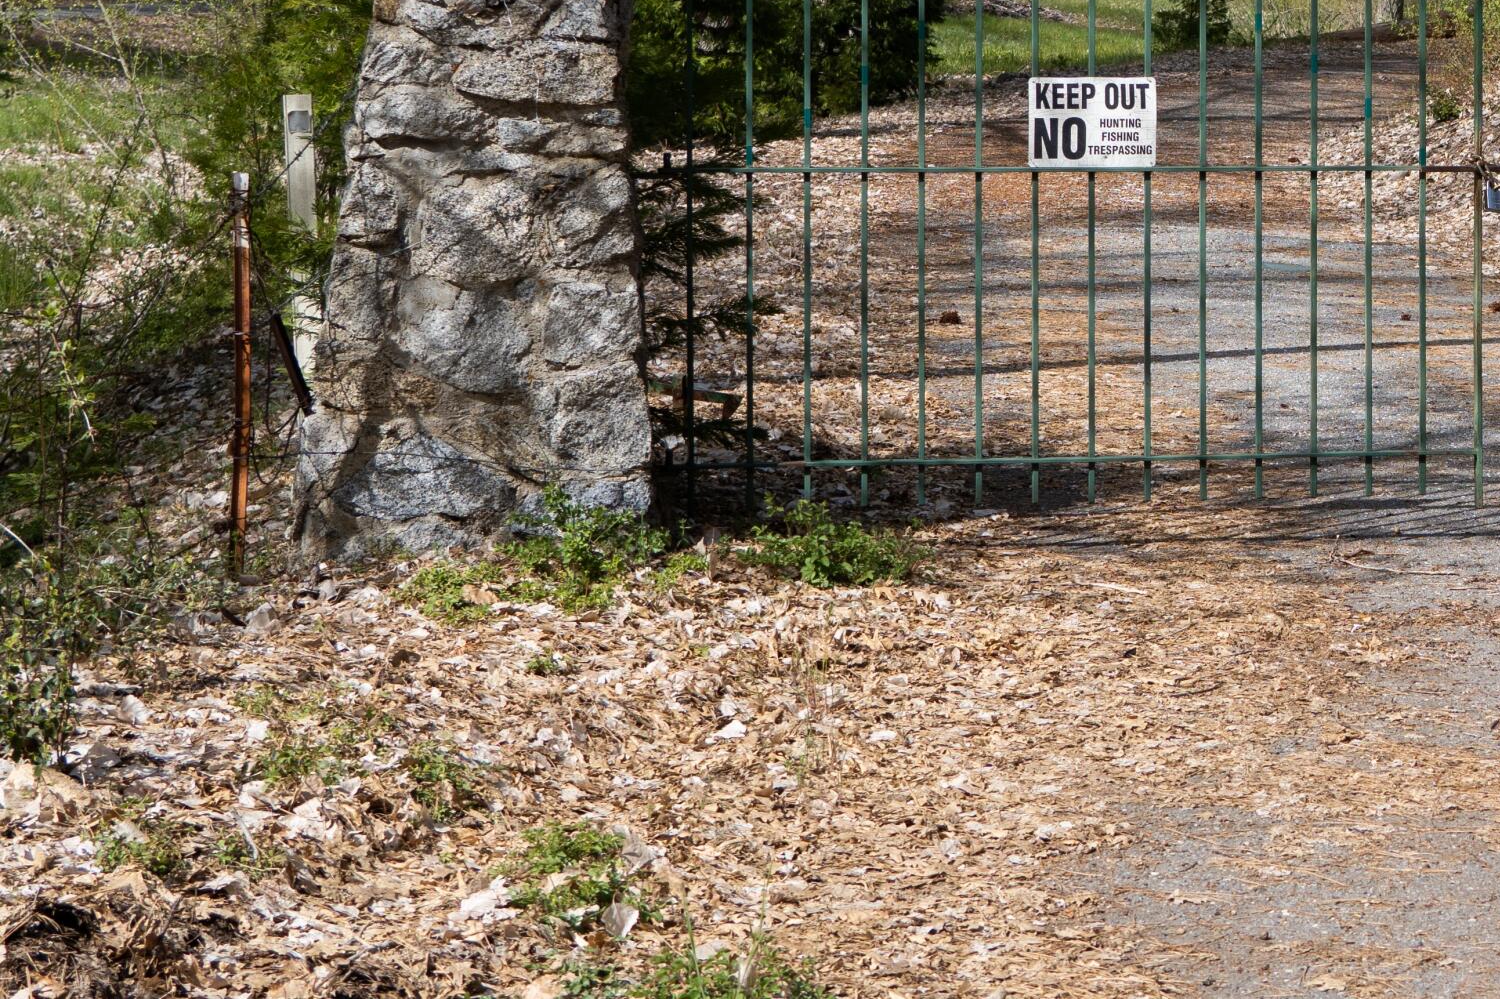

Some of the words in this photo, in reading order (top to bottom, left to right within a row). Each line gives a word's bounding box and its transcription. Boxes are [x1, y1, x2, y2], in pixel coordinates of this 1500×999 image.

[1035, 83, 1096, 110] KEEP
[1104, 82, 1150, 110] OUT
[1099, 118, 1142, 129] HUNTING
[1034, 116, 1087, 160] NO
[1101, 132, 1140, 142] FISHING
[1088, 145, 1153, 155] TRESPASSING
